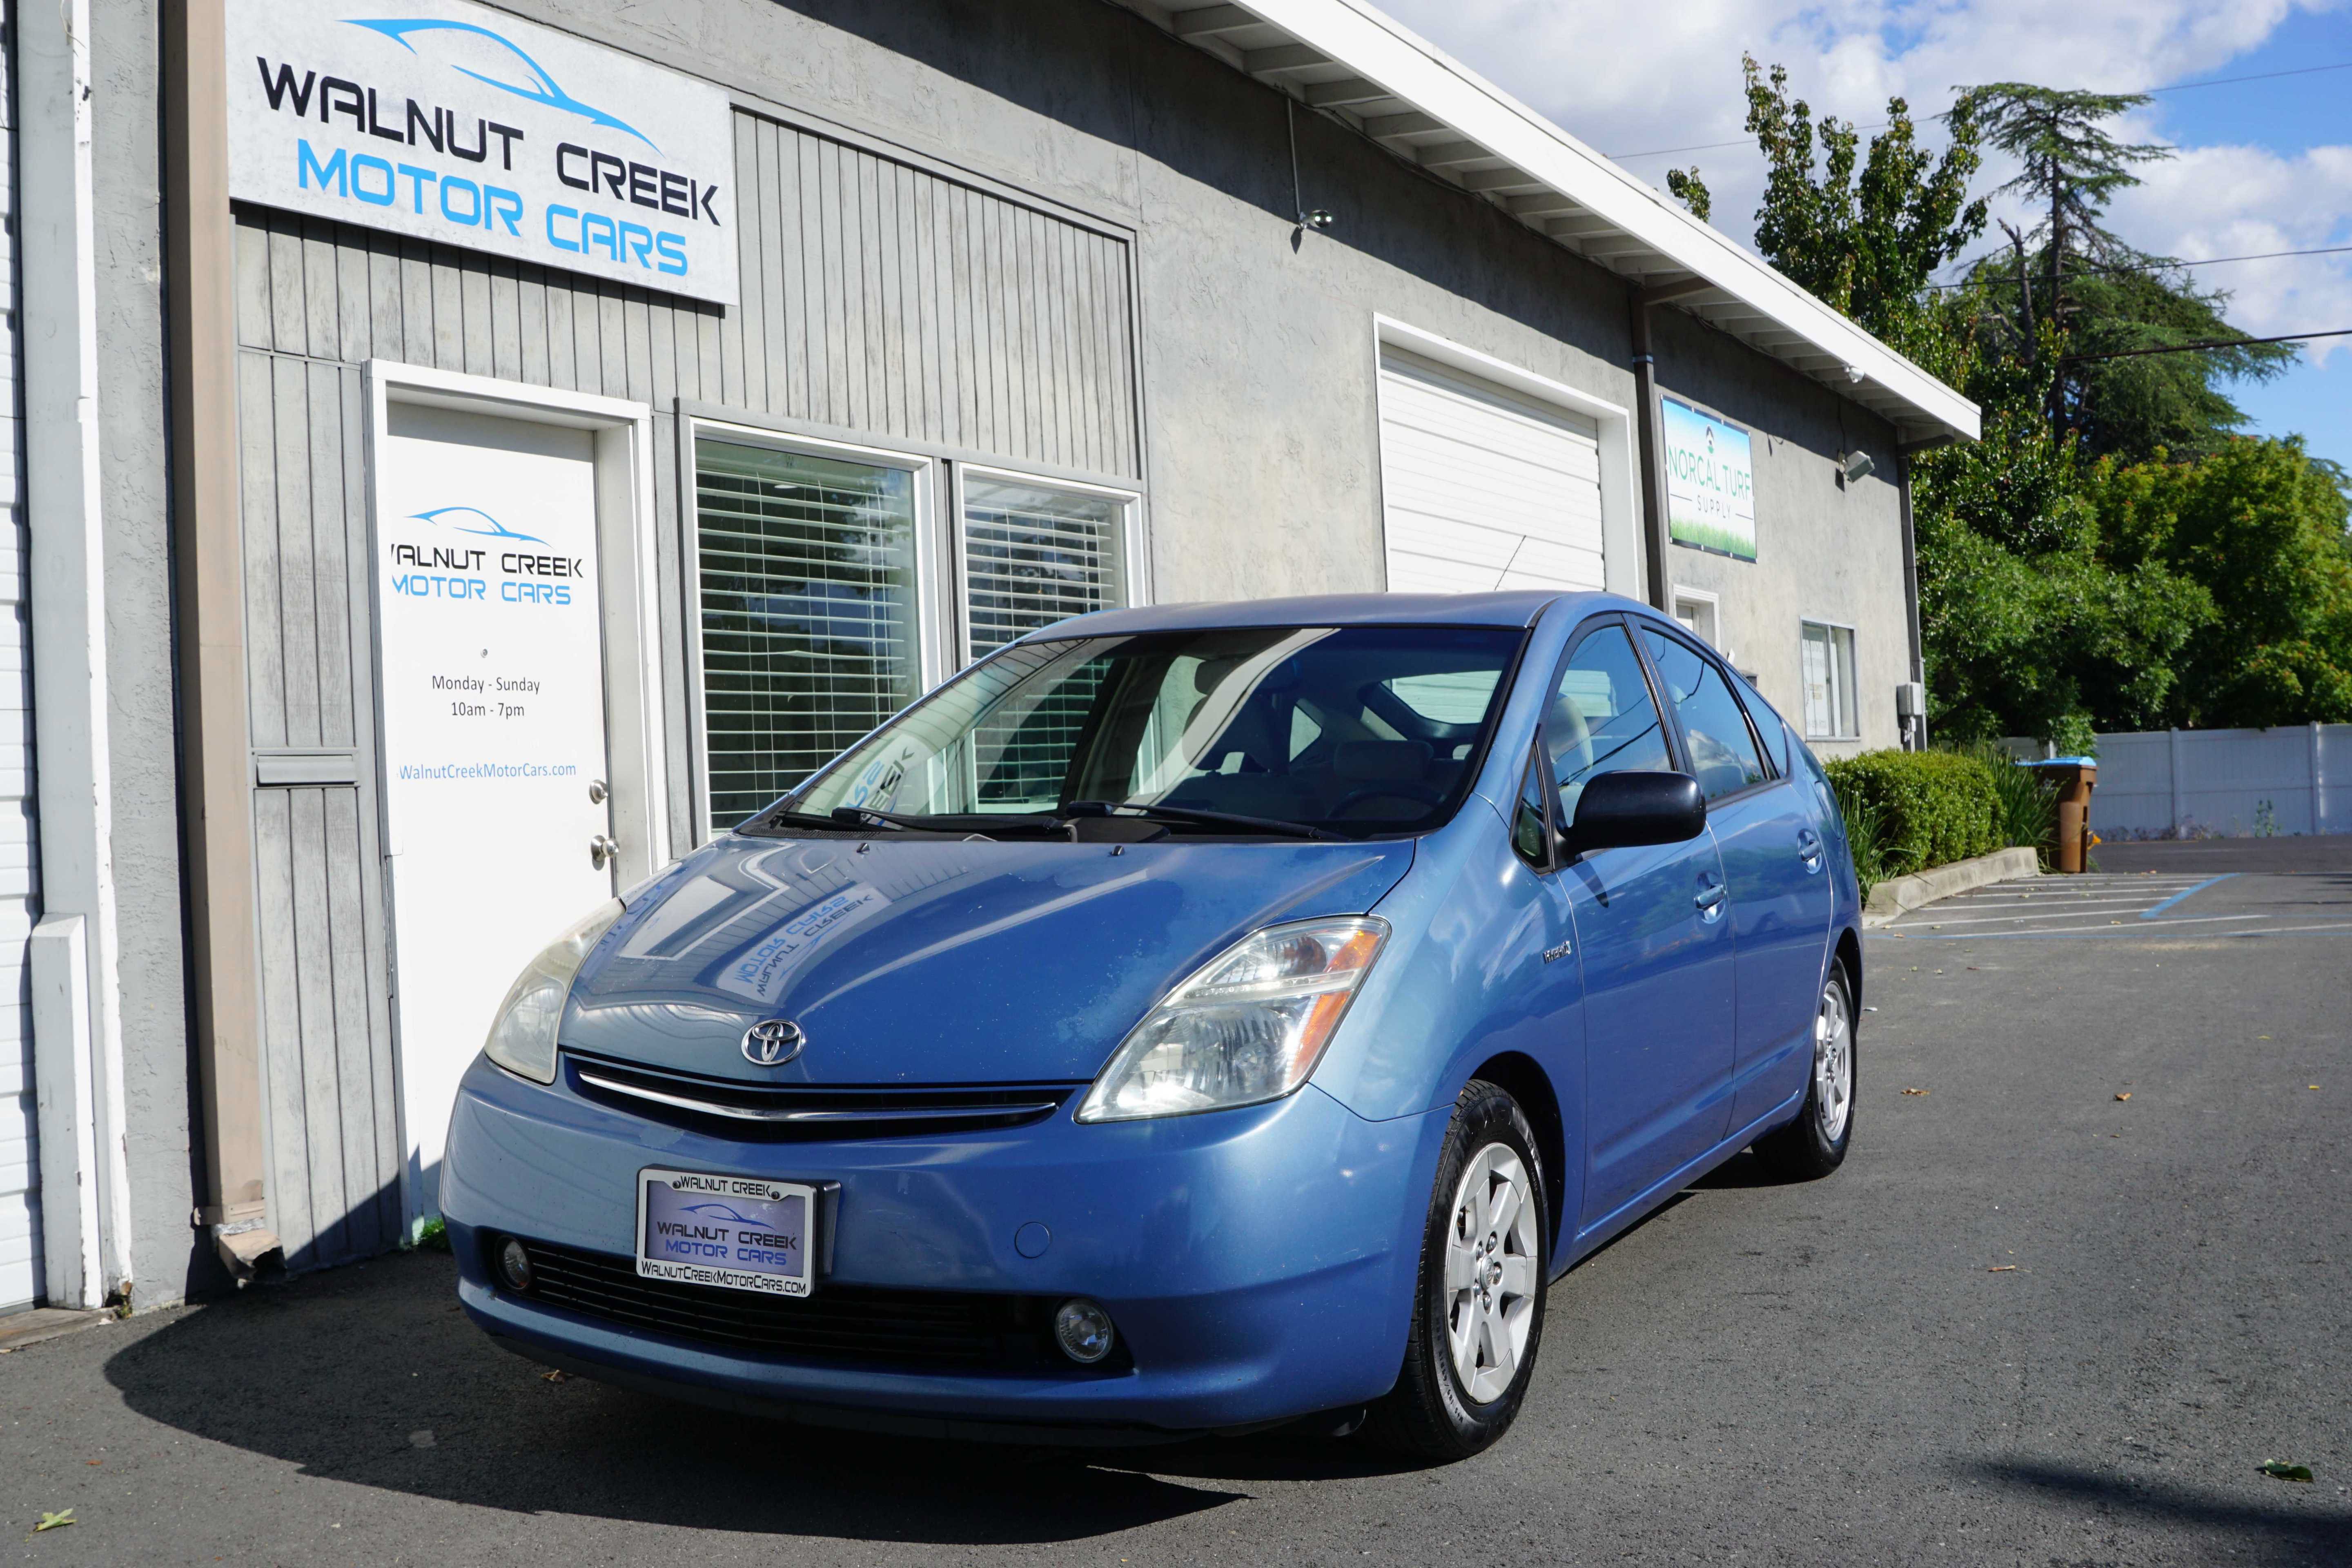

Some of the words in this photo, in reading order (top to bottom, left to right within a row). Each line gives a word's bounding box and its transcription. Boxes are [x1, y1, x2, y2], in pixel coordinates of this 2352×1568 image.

[257, 56, 523, 171] WALNUT
[556, 142, 720, 227] CREEK
[297, 139, 523, 237] MOTOR
[546, 204, 688, 276] CARS
[1668, 445, 1721, 491] NORCAL
[1722, 464, 1750, 500] TURF
[1697, 495, 1731, 519] SUPPLY
[391, 544, 486, 570] ALNUT
[502, 553, 584, 578] CREEK
[392, 574, 486, 600] MOTOR
[501, 582, 570, 605] CARS
[432, 676, 484, 694] Monday
[497, 677, 539, 694] Sunday
[451, 702, 486, 716] 10am
[498, 703, 524, 719] 7pm
[399, 763, 576, 779] WalnutCreekMotorCars.com
[681, 1176, 728, 1192] WALNUT
[732, 1182, 770, 1196] CREEK
[657, 1221, 729, 1241] WALNUT
[738, 1232, 796, 1250] CREEK
[666, 1239, 728, 1258] MOTOR
[737, 1248, 786, 1265] CARS
